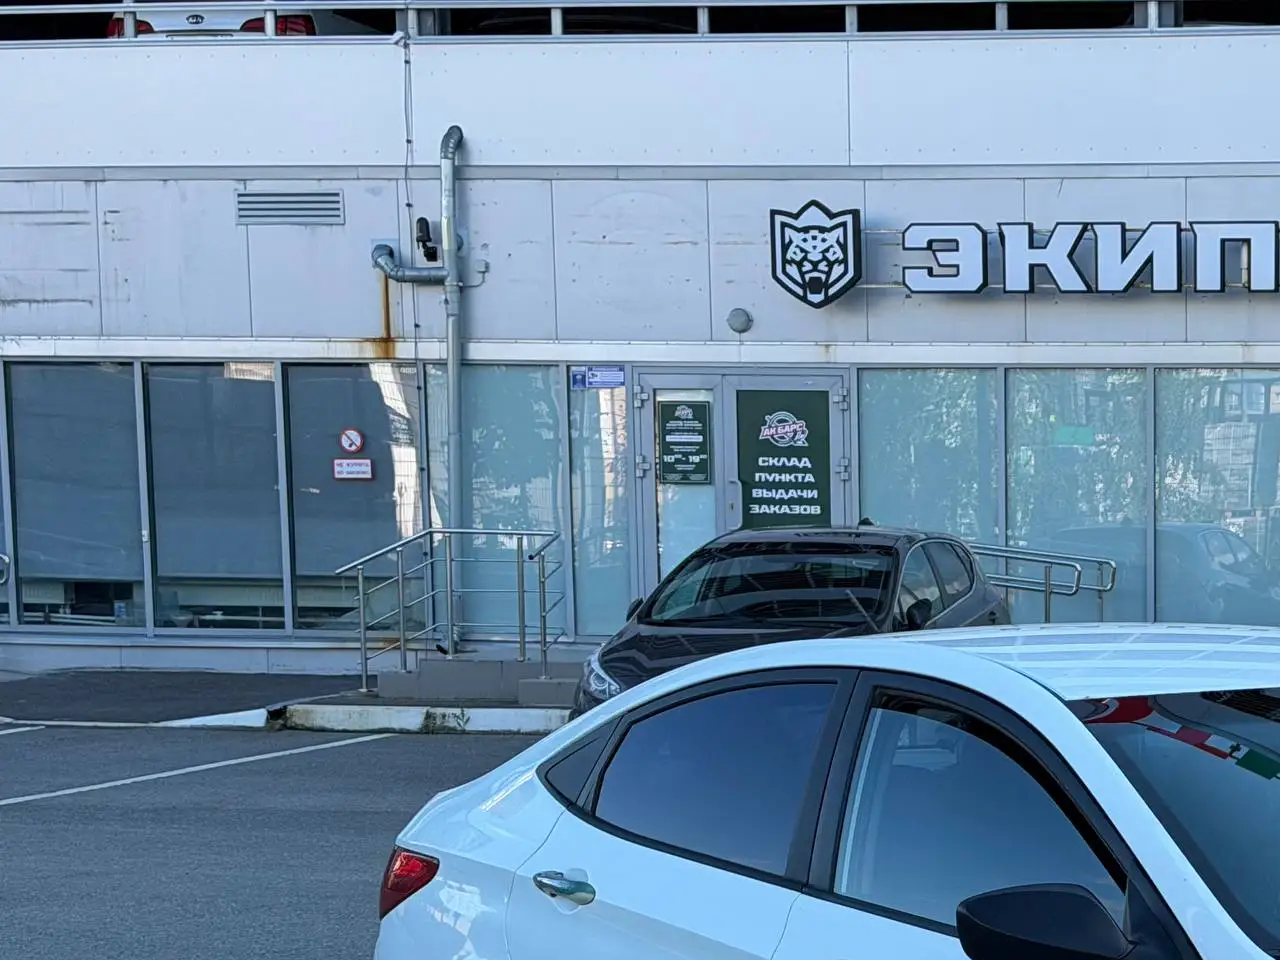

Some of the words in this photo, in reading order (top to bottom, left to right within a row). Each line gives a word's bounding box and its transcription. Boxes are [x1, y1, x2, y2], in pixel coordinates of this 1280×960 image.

[763, 427, 777, 436] АК
[777, 423, 803, 434] БАРС
[758, 456, 812, 468] СКЛАД
[755, 472, 815, 482] ПУНКТА
[752, 488, 818, 500] ВЫДАЧИ
[749, 504, 821, 514] ЗАКАЗОВ
